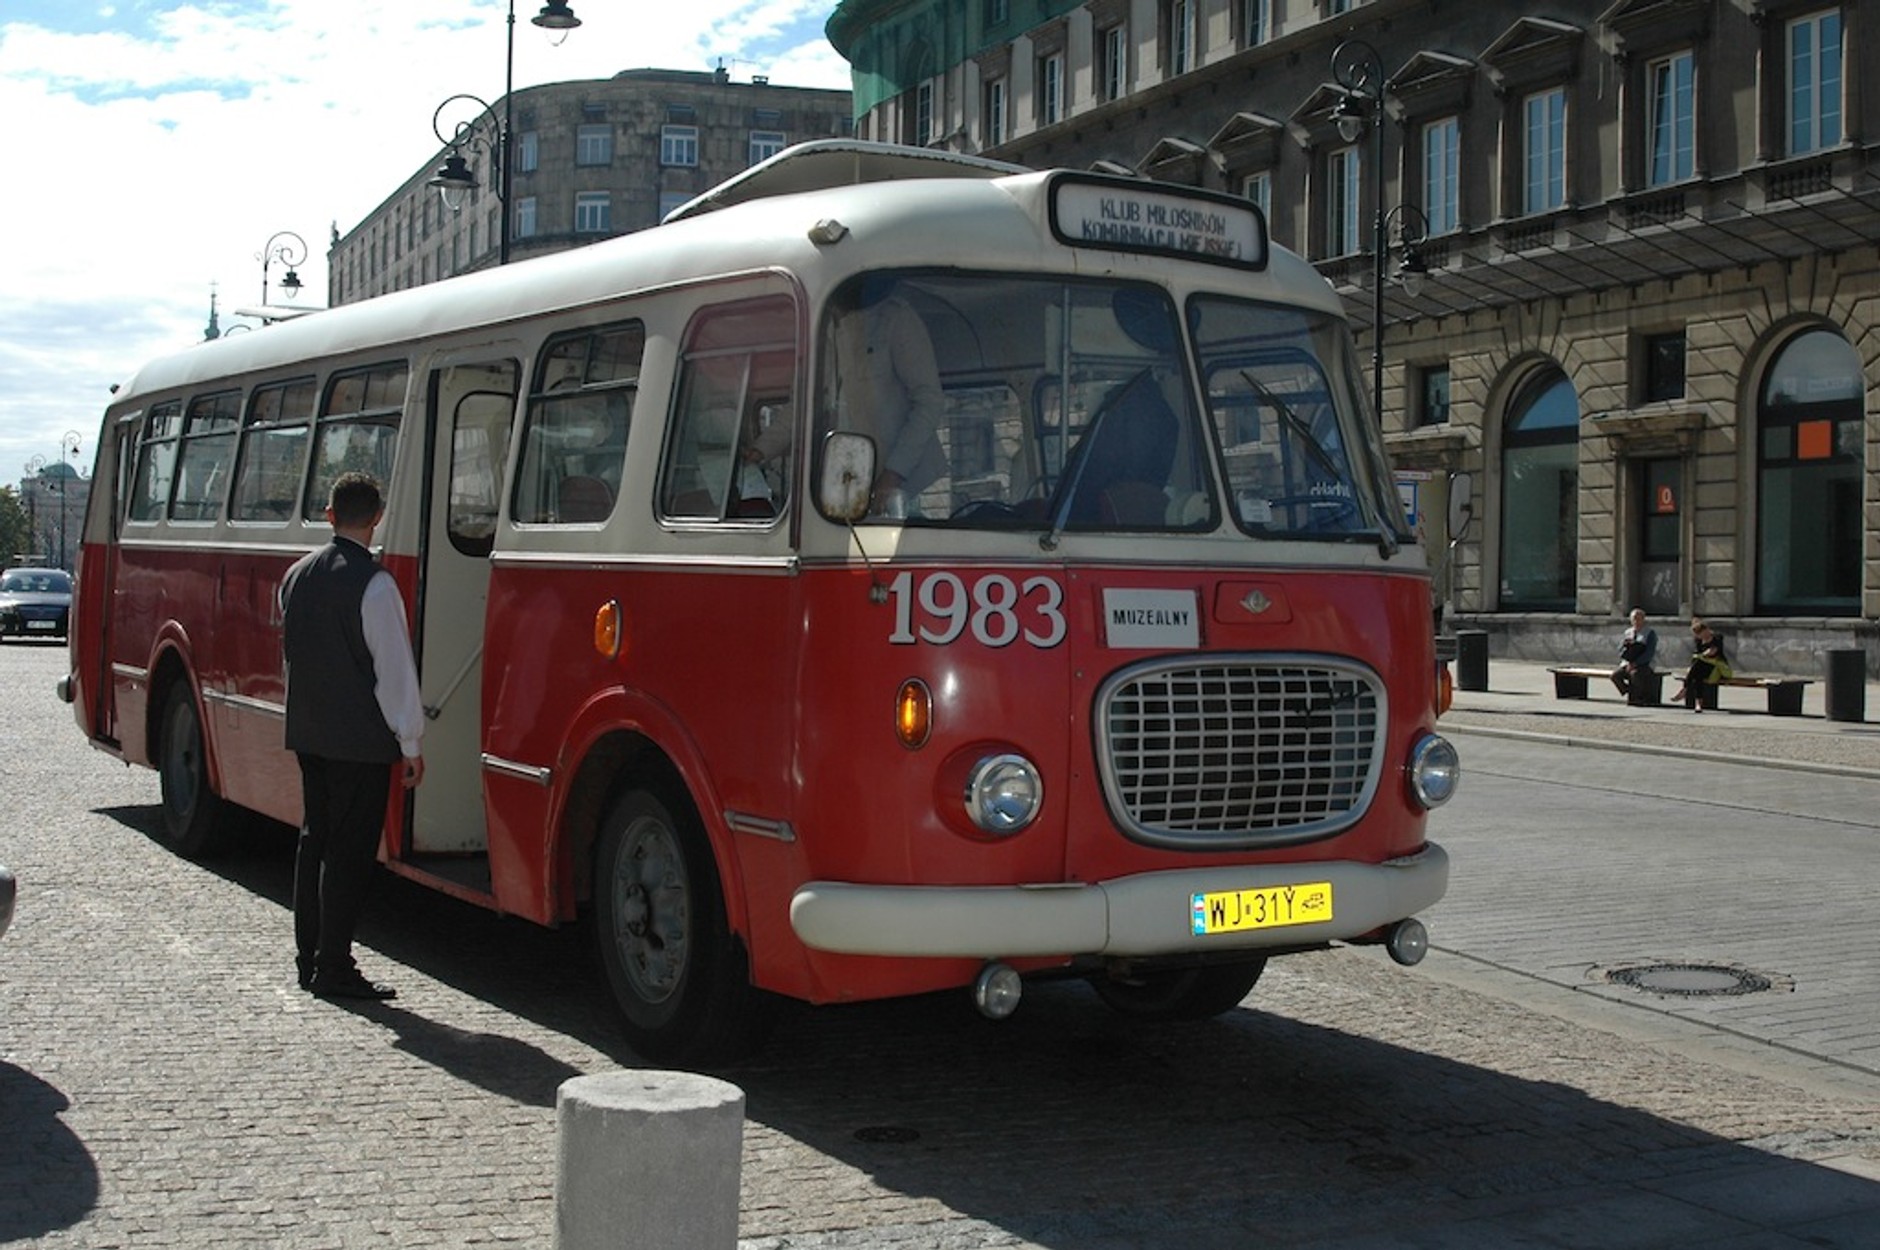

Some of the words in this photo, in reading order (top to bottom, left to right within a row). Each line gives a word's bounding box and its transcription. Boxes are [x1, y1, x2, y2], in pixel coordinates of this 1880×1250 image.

[1100, 197, 1140, 222] KLUB
[888, 570, 1069, 649] 1983
[1112, 609, 1189, 626] MUZEALNY
